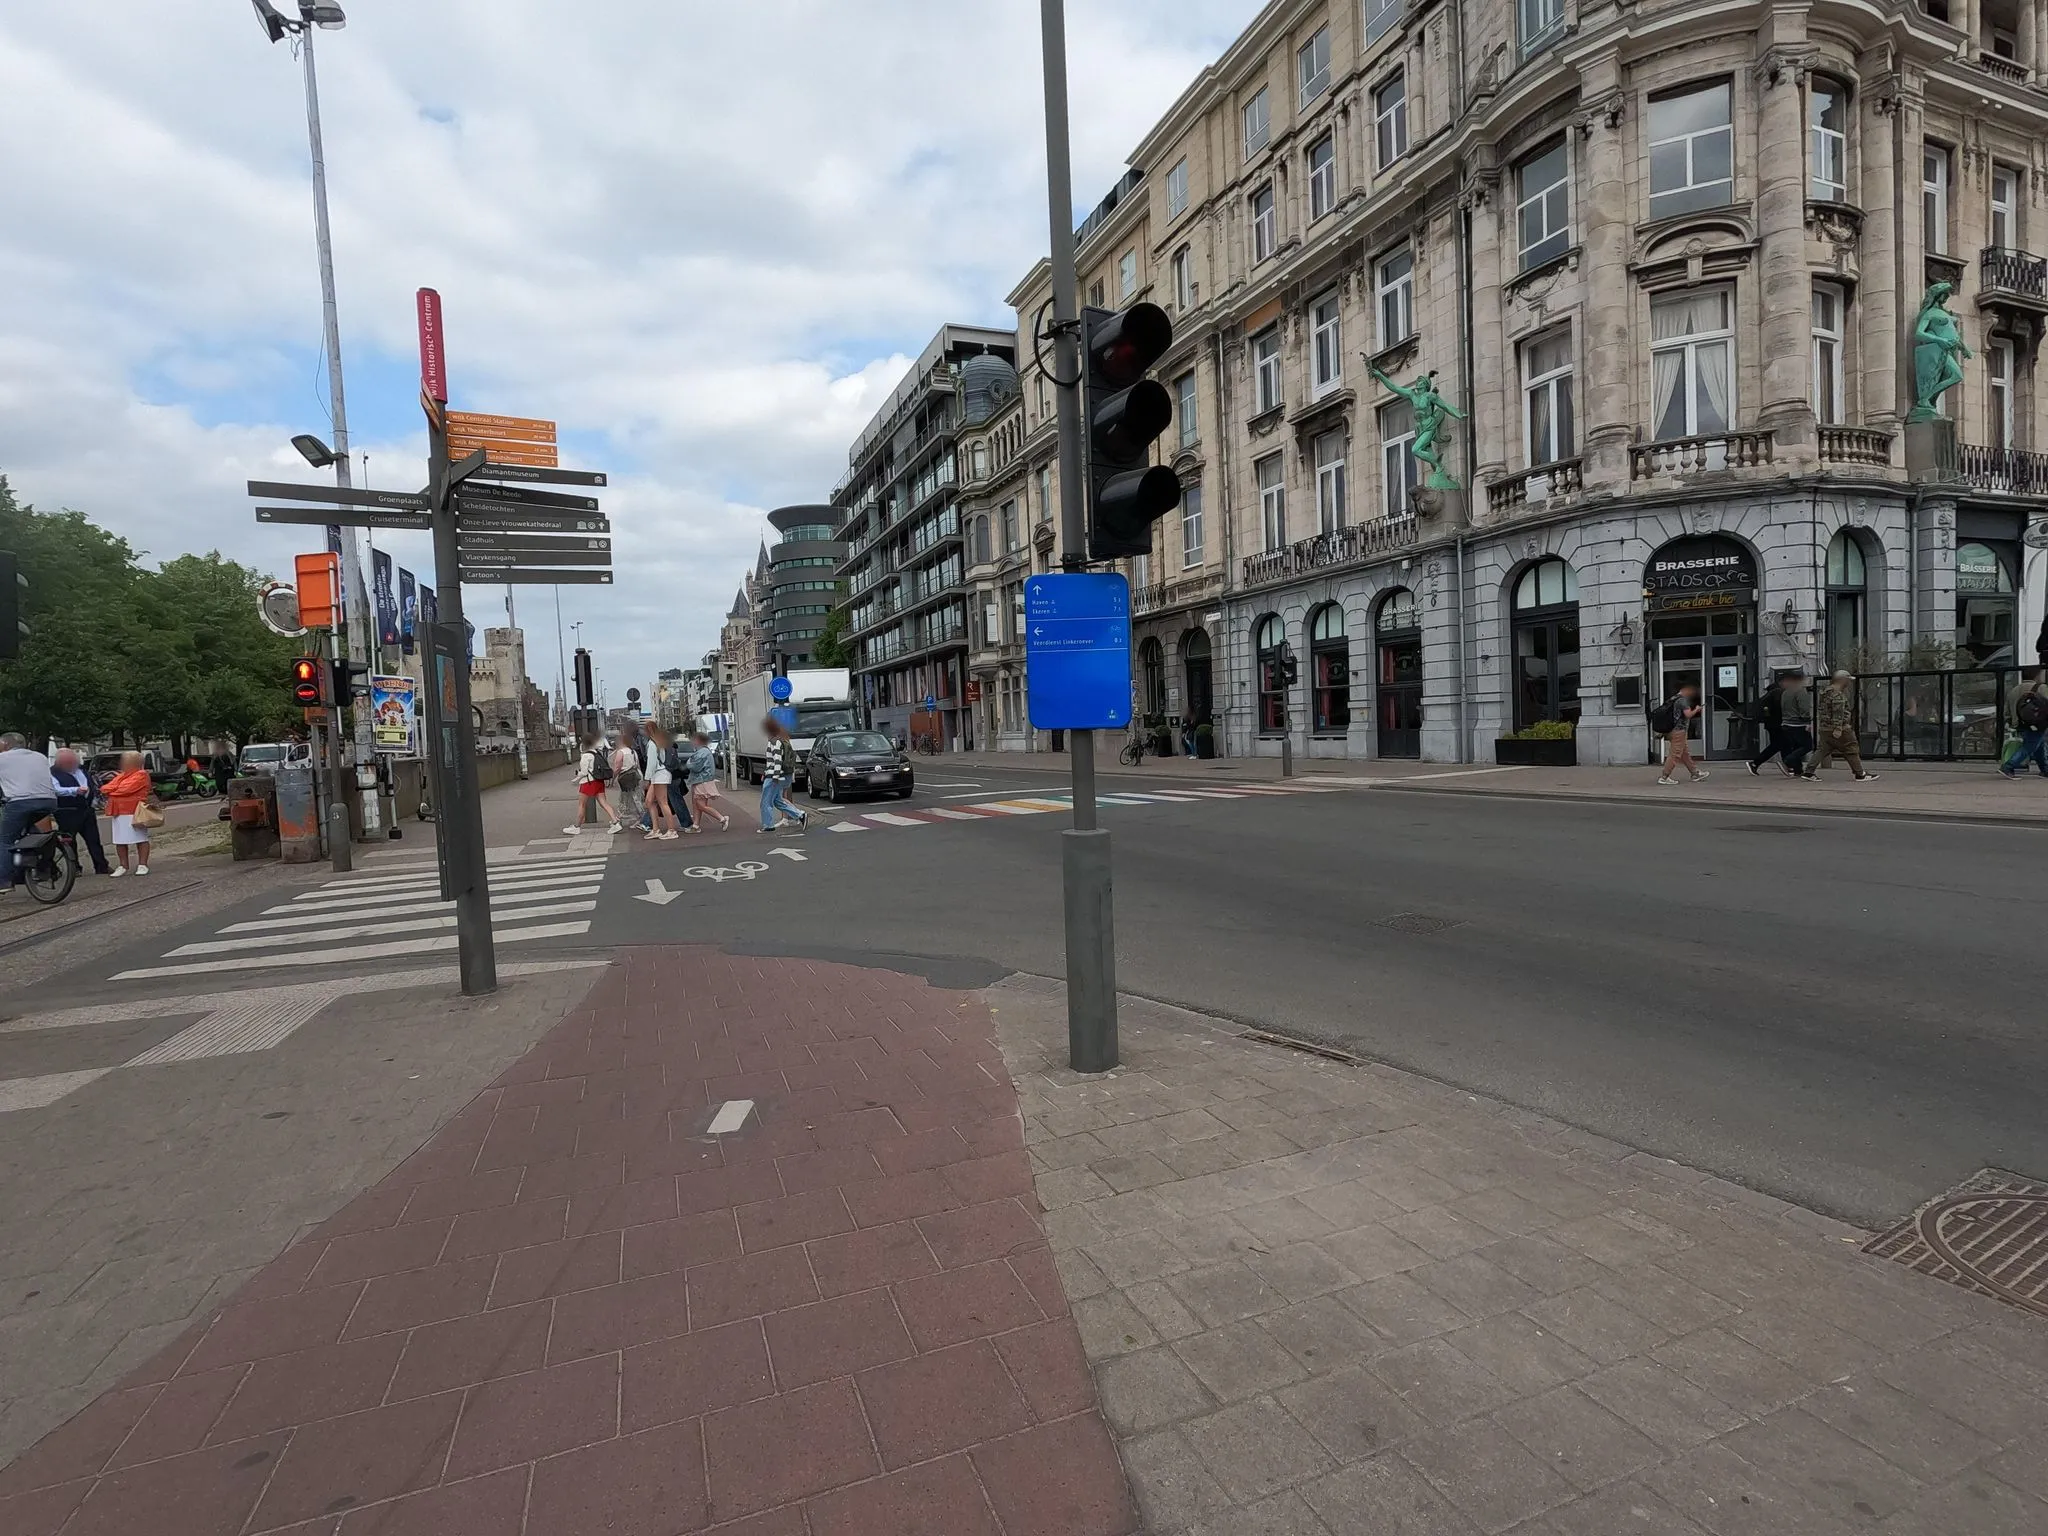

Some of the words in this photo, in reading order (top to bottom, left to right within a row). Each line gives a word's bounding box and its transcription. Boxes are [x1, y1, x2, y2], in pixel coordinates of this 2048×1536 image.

[424, 295, 433, 332] Centrum
[426, 334, 436, 376] Historisch
[429, 380, 438, 396] wijk
[467, 427, 506, 436] Theaterbuurt
[482, 468, 539, 478] Diamantmuseum
[462, 485, 491, 494] Museum
[502, 490, 522, 498] Reede
[378, 495, 423, 506] Groenplaats
[463, 502, 515, 513] Scheldetochten
[370, 515, 423, 524] Cruiseterminal
[463, 519, 562, 528] Onze-Lieve-Vrouwekathedraal
[466, 554, 516, 562] Vlaeykensgang
[1656, 556, 1740, 572] BRASSERIE
[1960, 564, 1997, 573] BRASSERIE
